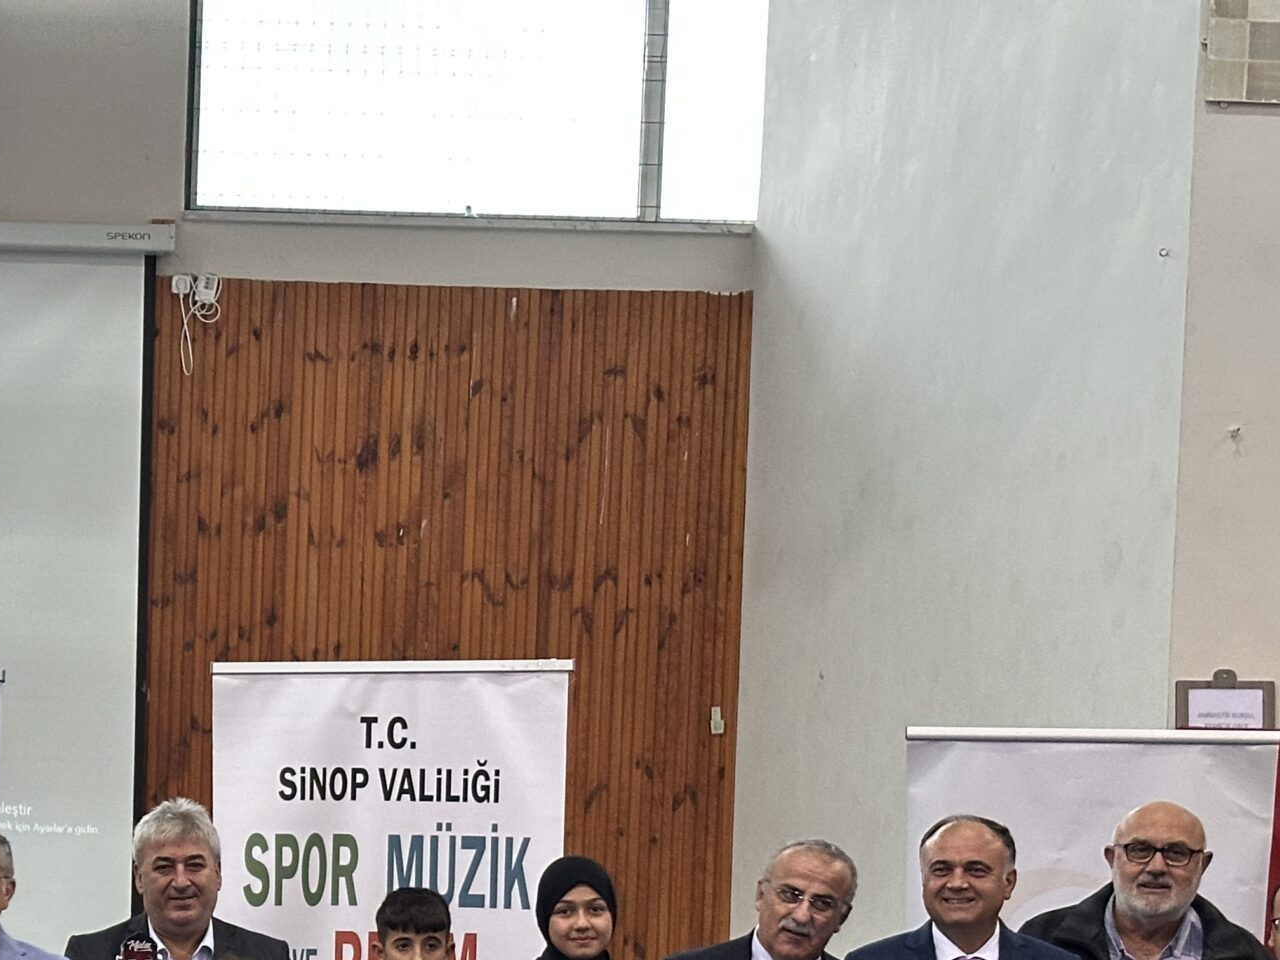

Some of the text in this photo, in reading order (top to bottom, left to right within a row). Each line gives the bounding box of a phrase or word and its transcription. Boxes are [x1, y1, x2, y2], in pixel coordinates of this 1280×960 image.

[360, 715, 417, 749] T.C.
[242, 822, 532, 910] SPOR MÜZİK
